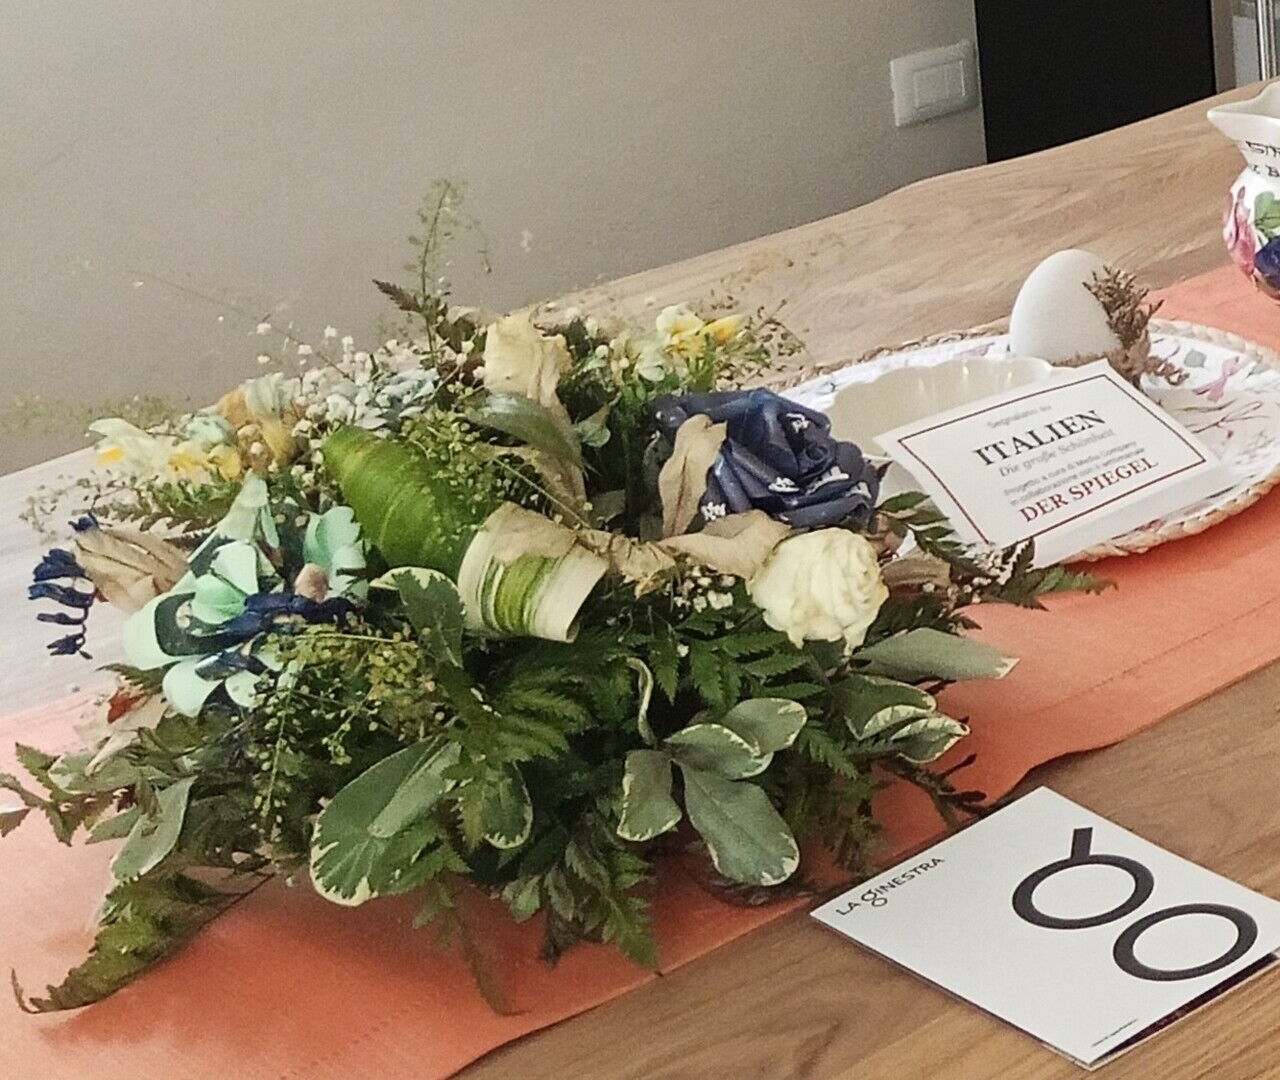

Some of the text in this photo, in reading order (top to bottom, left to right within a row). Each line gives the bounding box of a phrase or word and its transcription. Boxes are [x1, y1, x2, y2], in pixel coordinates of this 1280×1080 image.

[973, 409, 1106, 466] ITALIEN
[1018, 456, 1160, 522] DER SPIEGEL
[835, 900, 862, 916] LA
